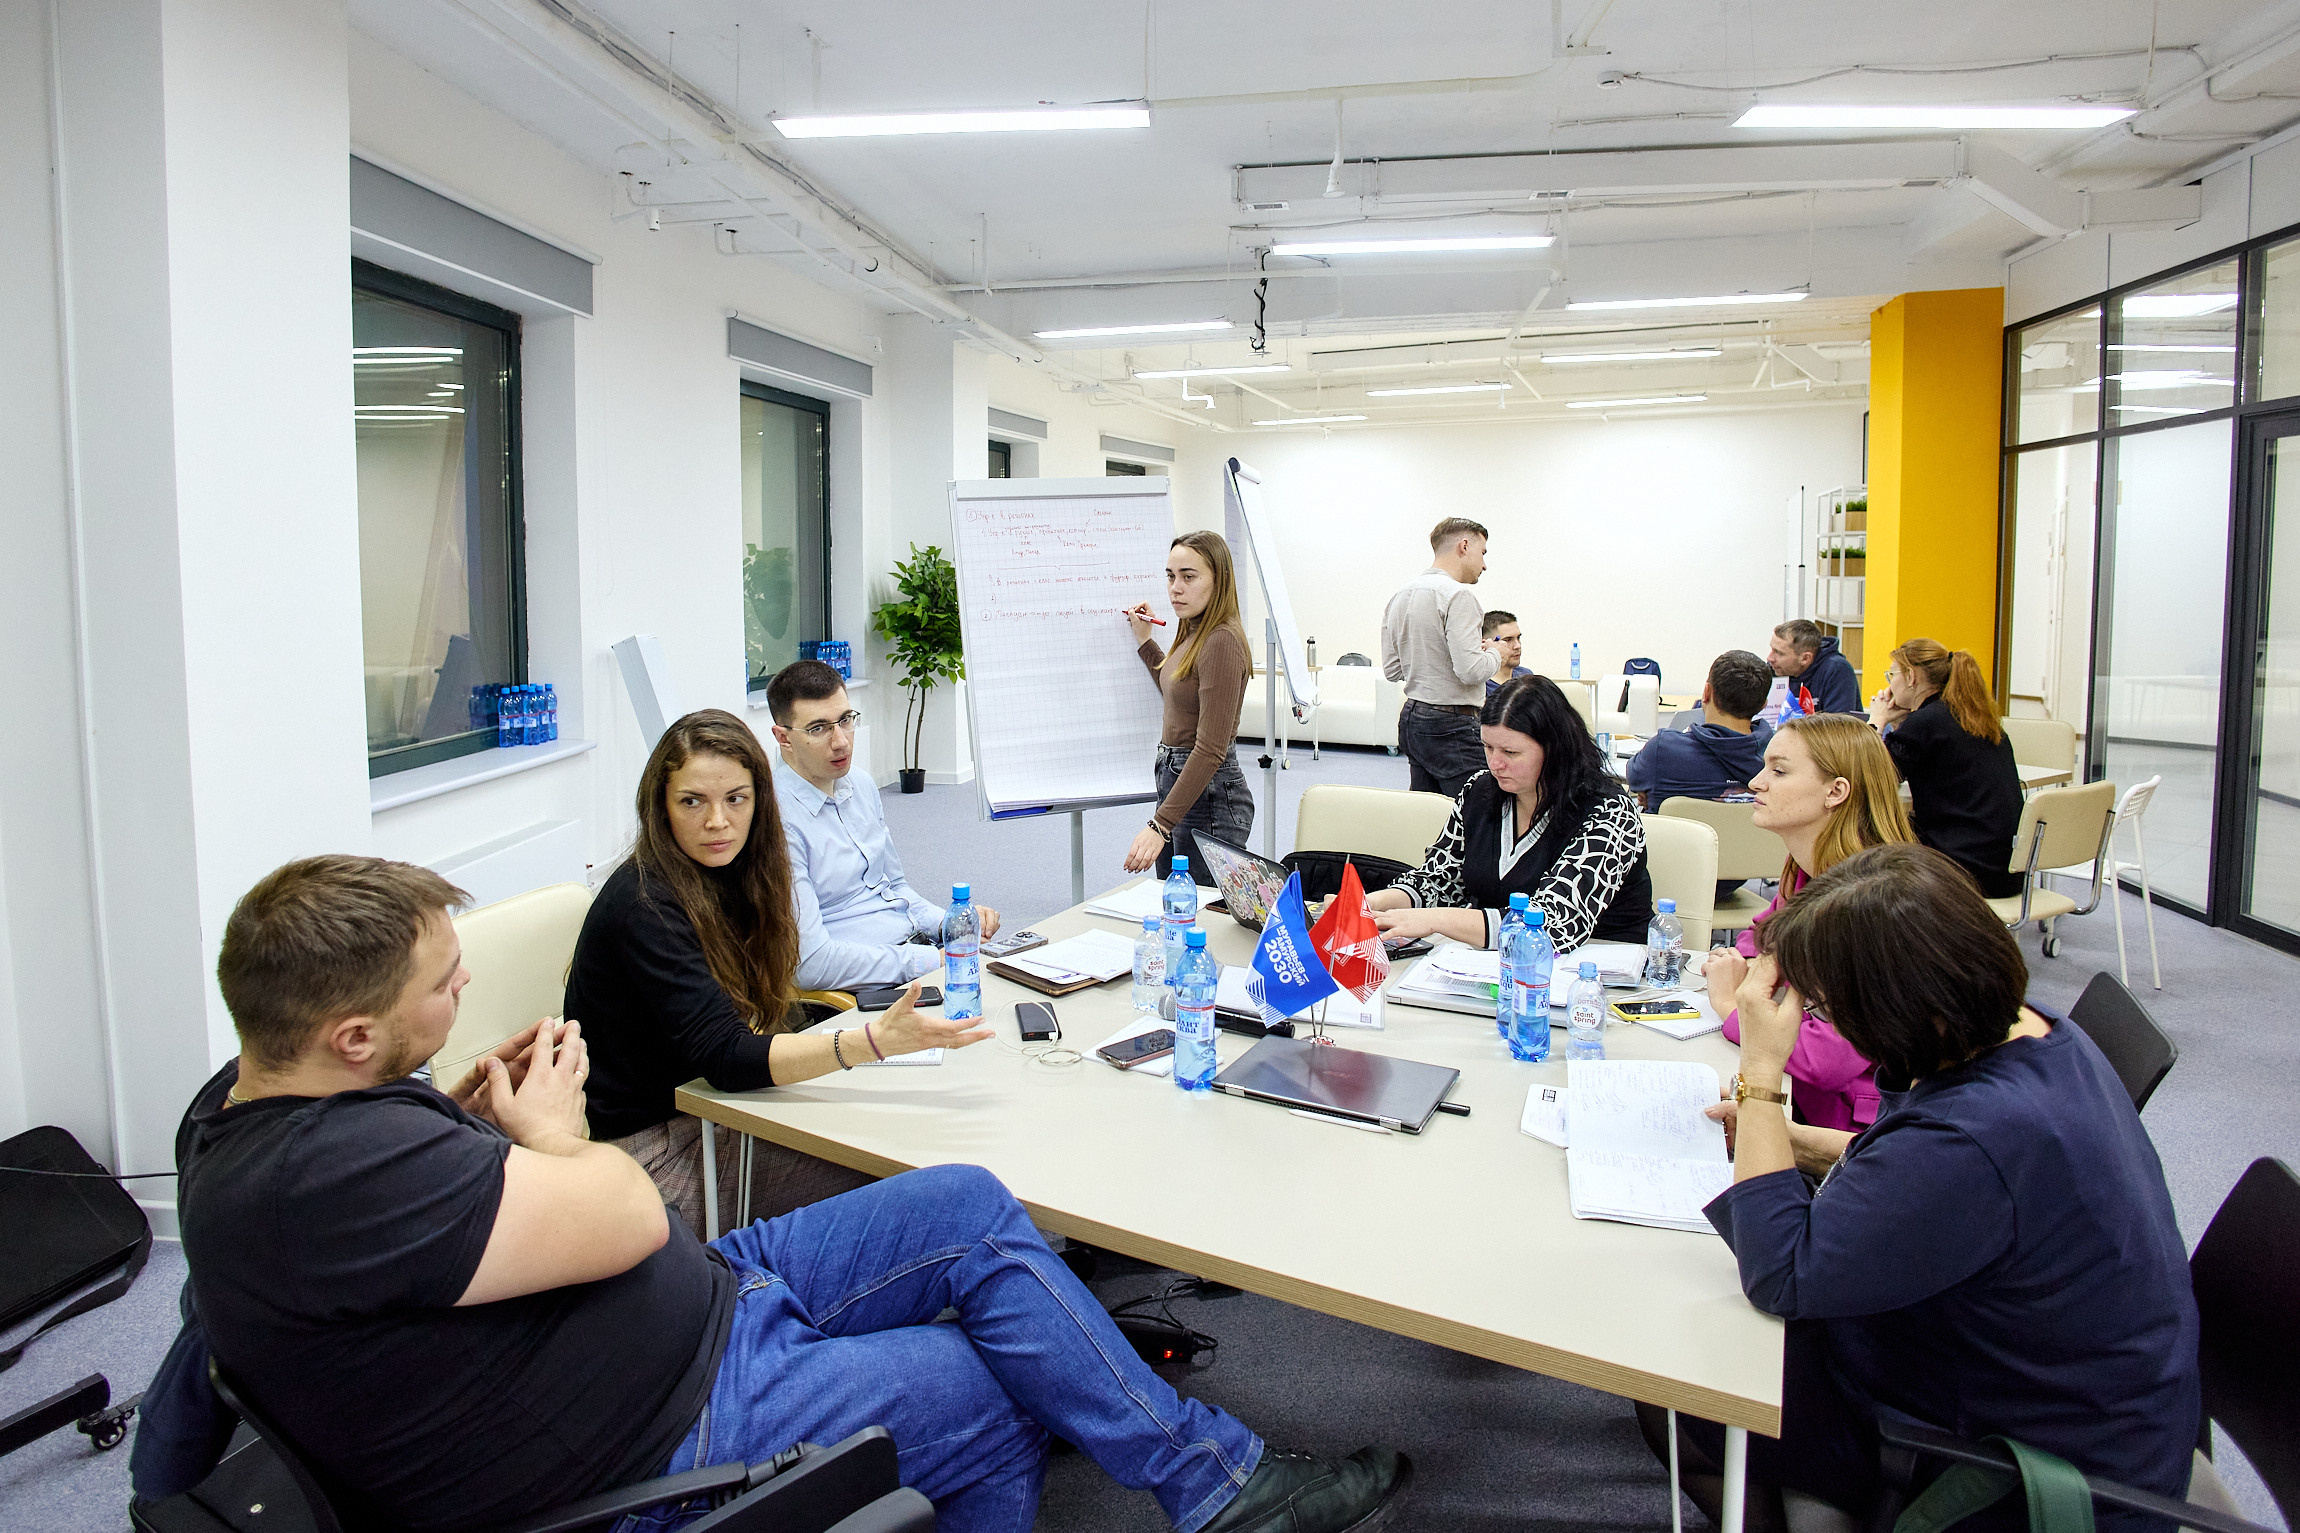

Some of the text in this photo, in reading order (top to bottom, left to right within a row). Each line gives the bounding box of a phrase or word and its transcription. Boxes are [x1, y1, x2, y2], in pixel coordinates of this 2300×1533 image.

[1264, 940, 1292, 984] 2030
[1574, 1016, 1596, 1025] spring
[1177, 1024, 1197, 1033] ква
